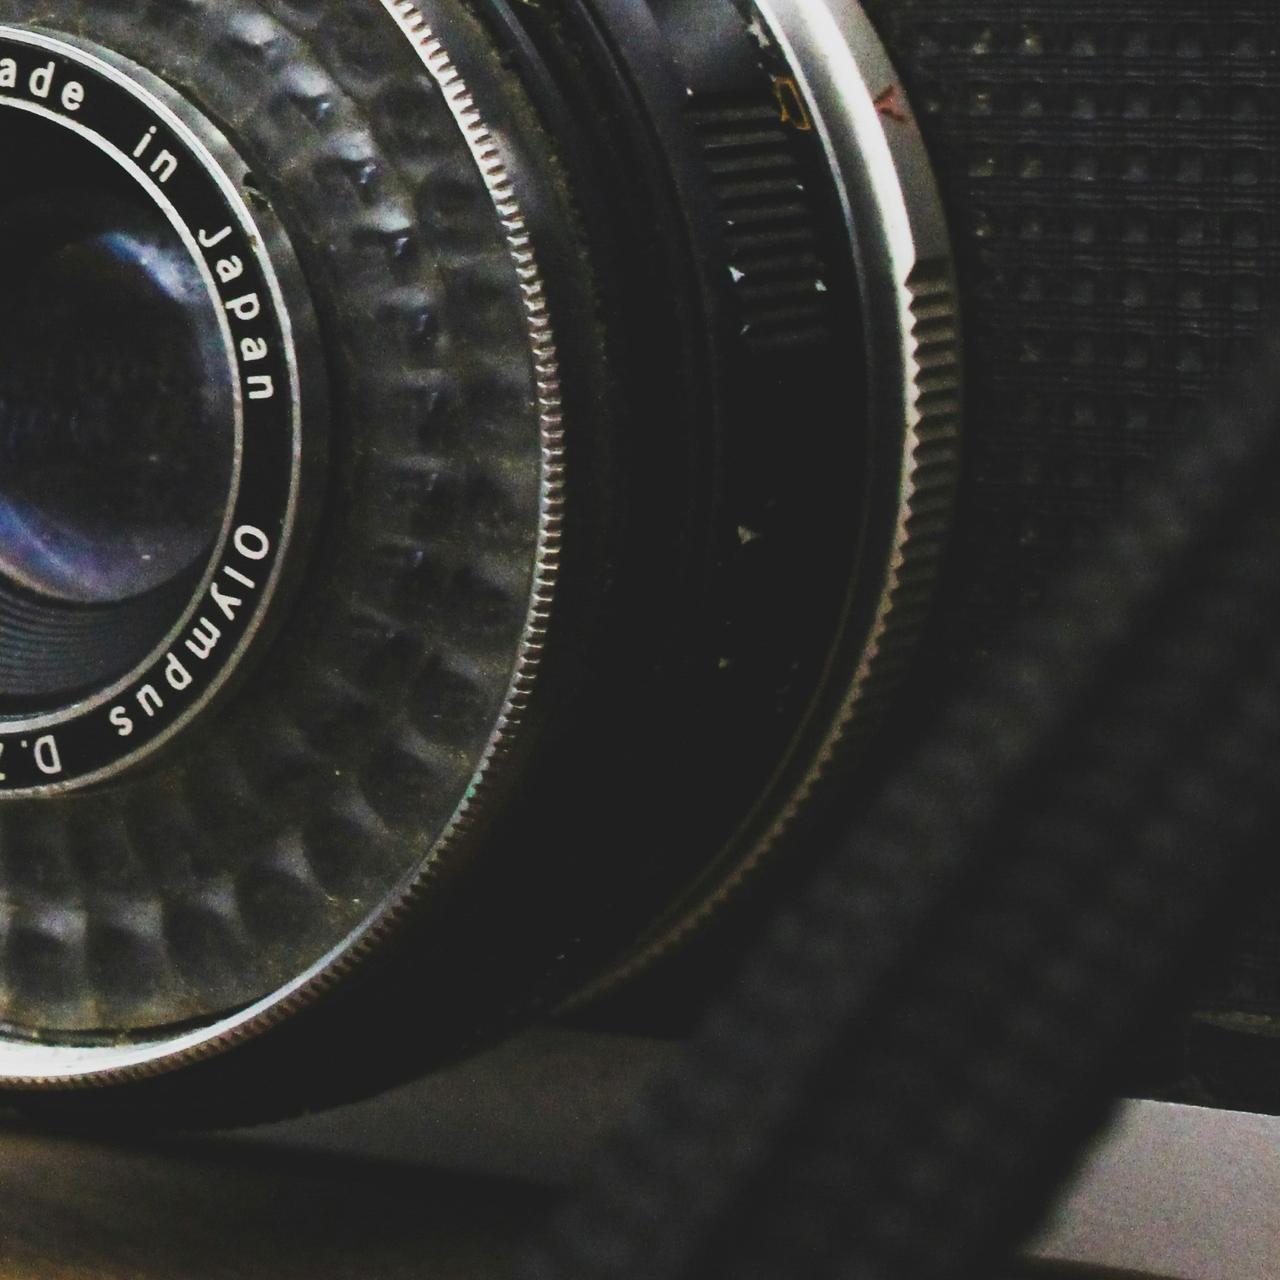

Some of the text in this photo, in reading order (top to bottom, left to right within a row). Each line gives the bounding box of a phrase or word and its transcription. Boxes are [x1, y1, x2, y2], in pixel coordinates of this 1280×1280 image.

[131, 124, 179, 184] in
[196, 224, 275, 401] Japan
[108, 523, 270, 737] Olympus
